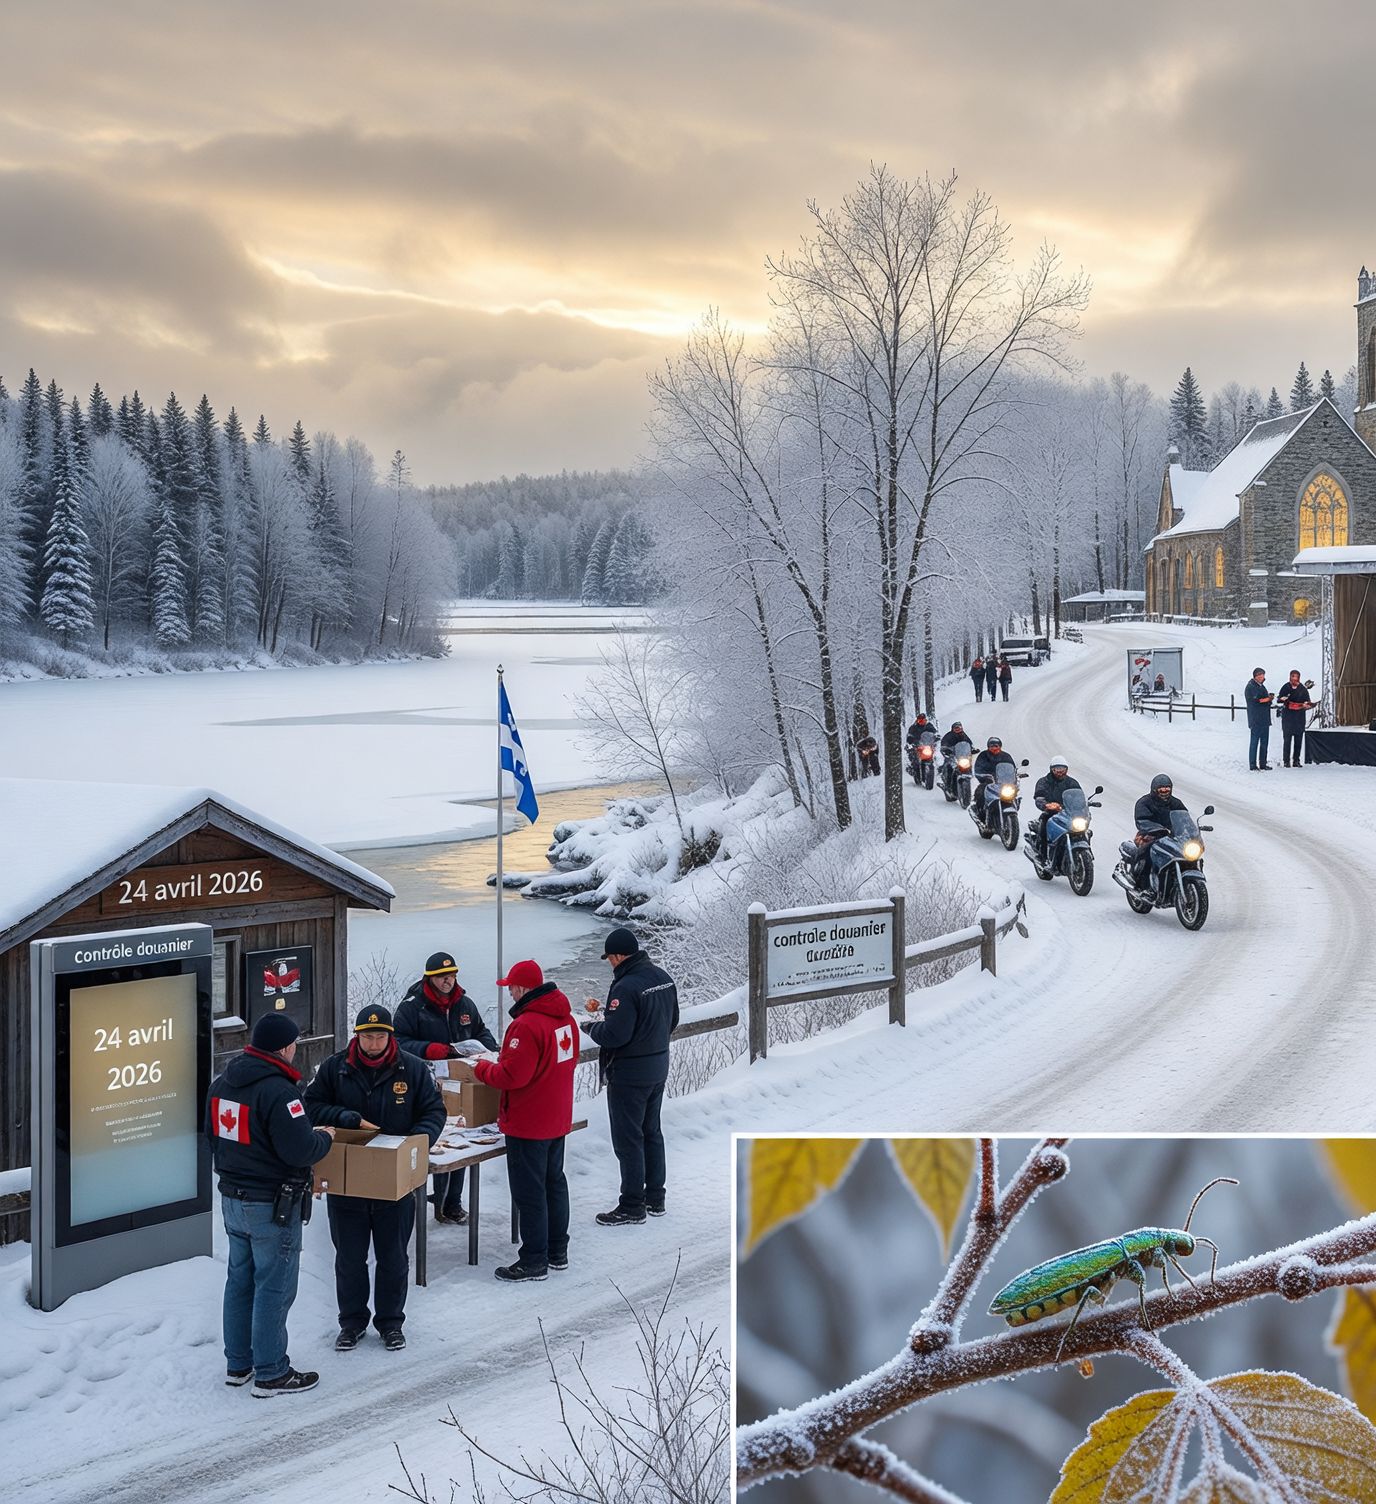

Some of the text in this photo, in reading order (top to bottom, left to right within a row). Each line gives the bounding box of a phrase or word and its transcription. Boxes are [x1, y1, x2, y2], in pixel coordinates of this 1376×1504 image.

[118, 870, 263, 905] 24 avril 2026
[830, 920, 886, 942] douanier
[137, 938, 194, 956] douanier
[94, 1018, 173, 1052] 24 avril
[107, 1060, 162, 1090] 2026
